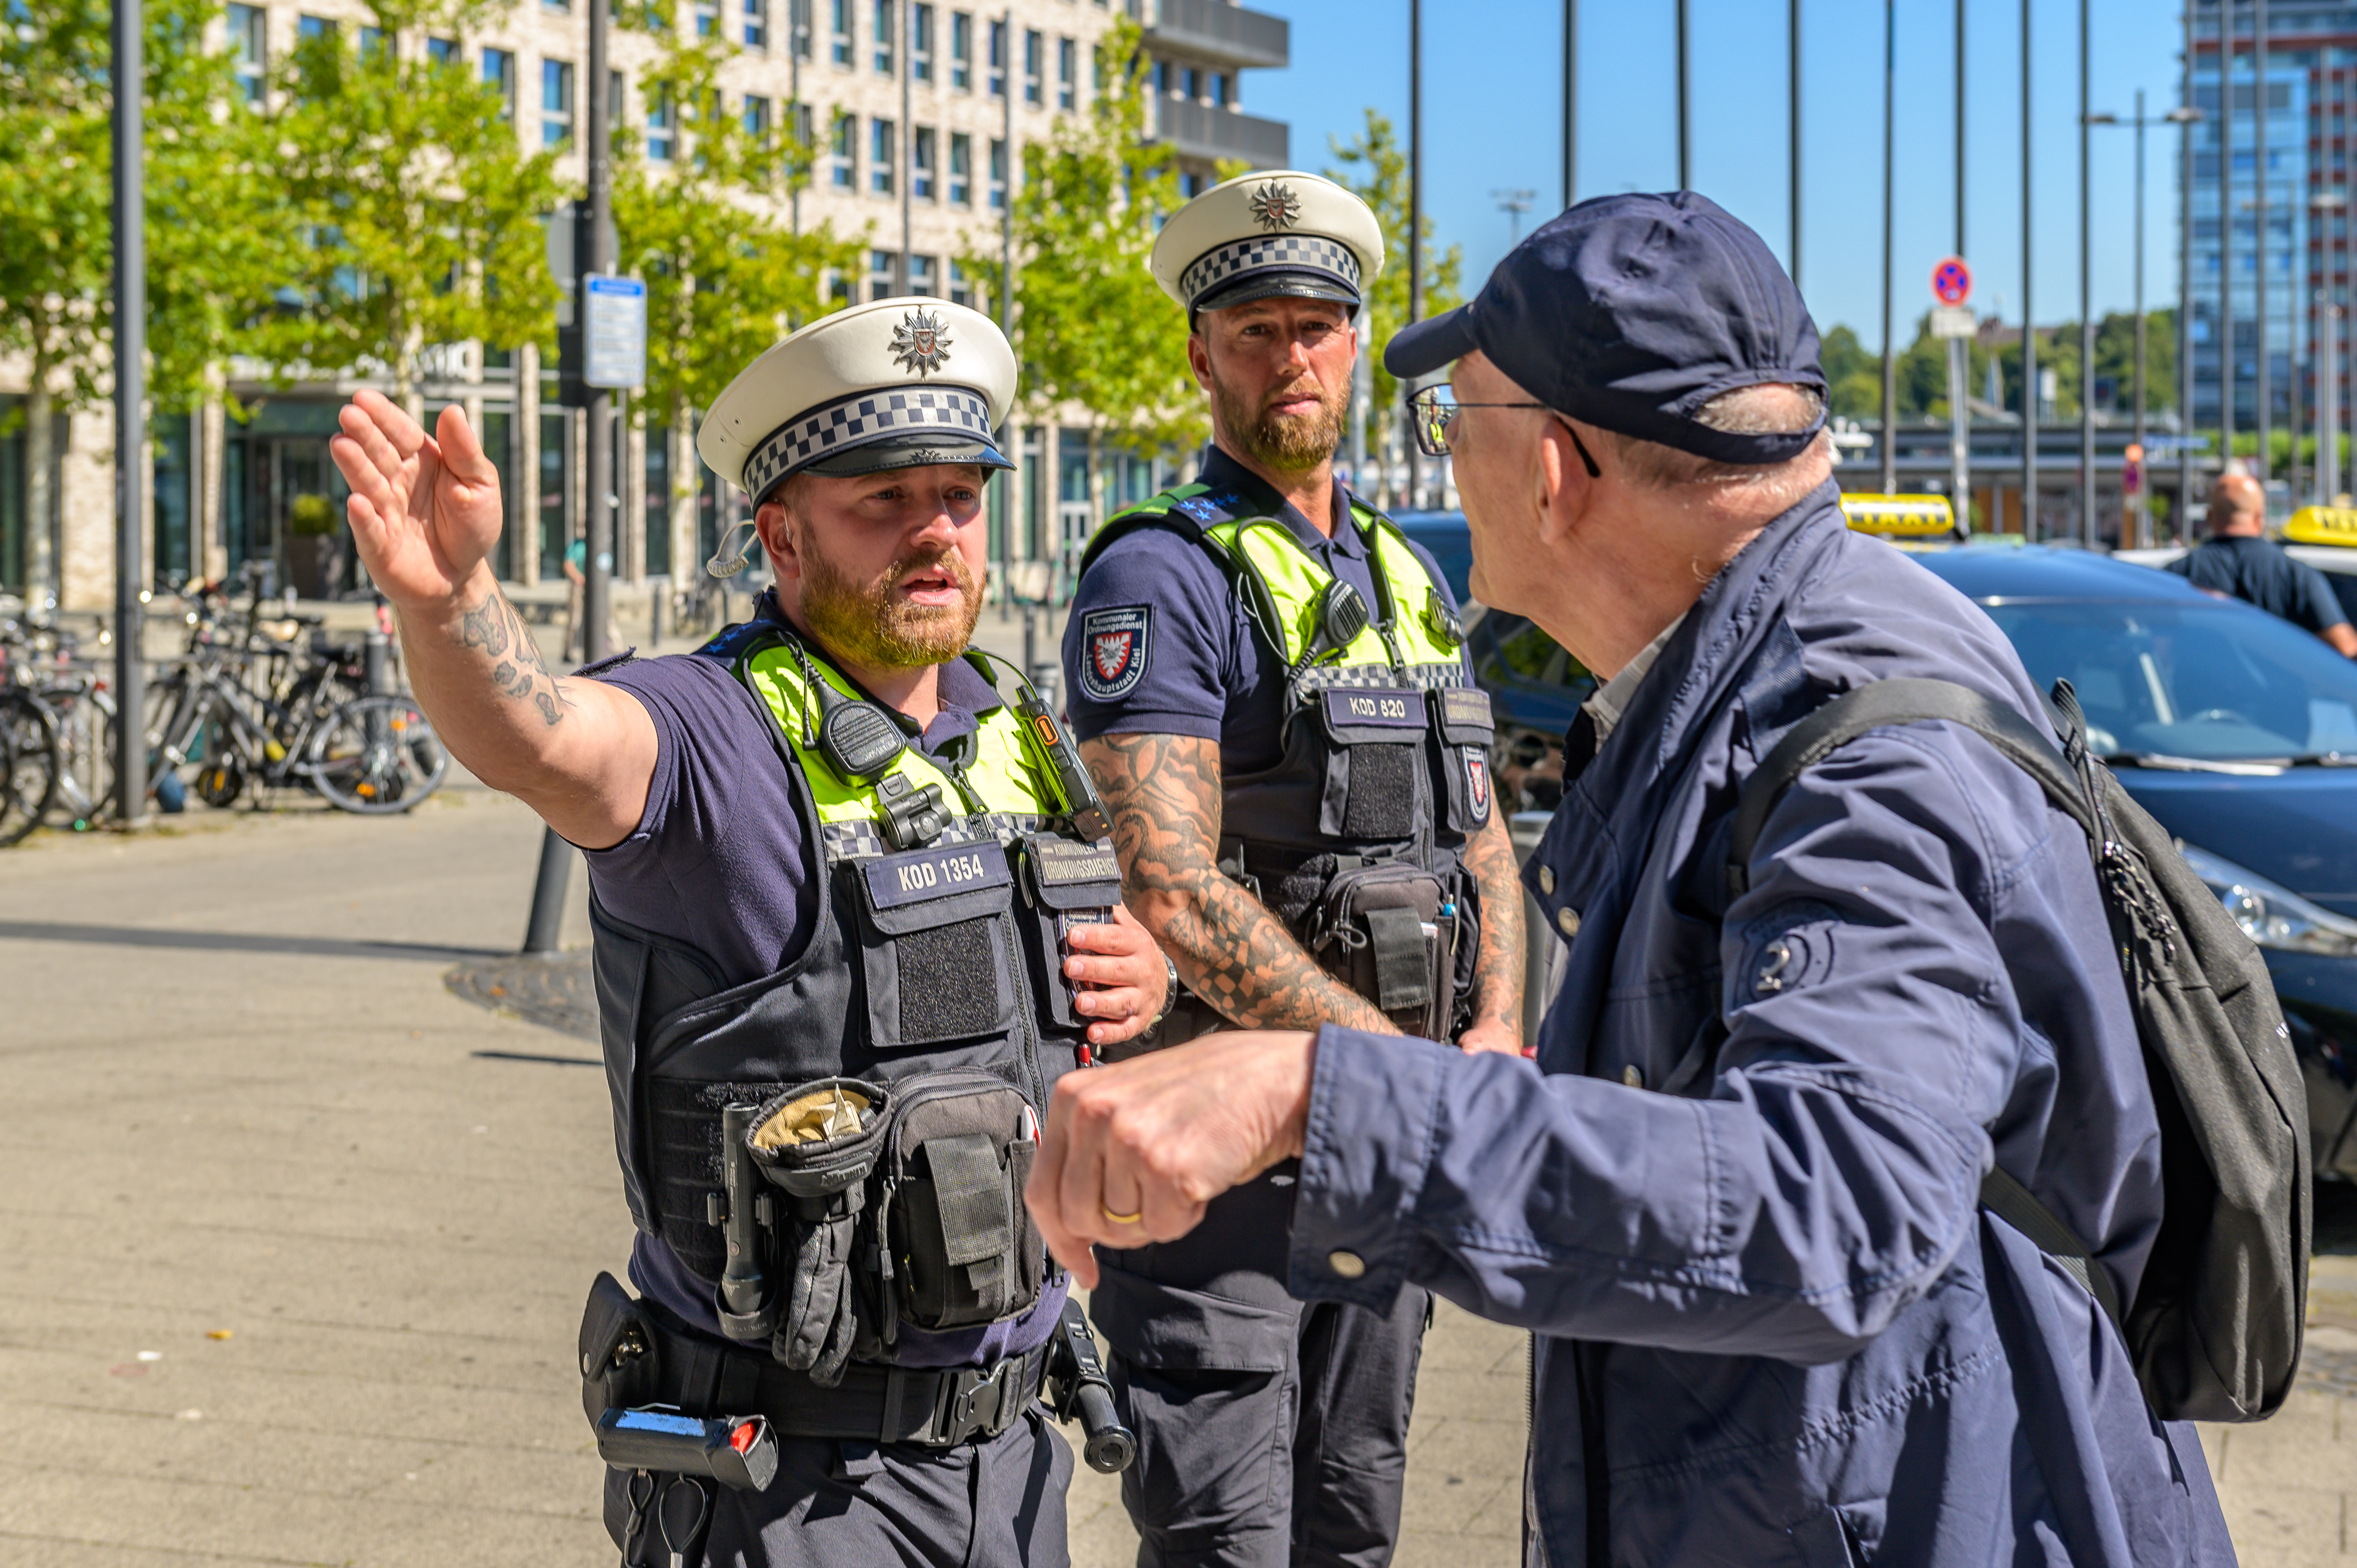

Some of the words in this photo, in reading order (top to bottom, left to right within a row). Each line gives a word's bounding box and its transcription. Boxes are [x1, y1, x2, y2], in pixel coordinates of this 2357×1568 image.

[1088, 621, 1143, 634] Ordnungsdienst
[1093, 613, 1137, 625] Kommunaler
[1086, 654, 1136, 694] Landeshauptstadt
[1131, 648, 1141, 667] Kiel
[1349, 697, 1377, 716] KOD
[1381, 699, 1405, 719] 820
[898, 864, 937, 892] KOD
[940, 853, 984, 883] 1354
[1044, 857, 1118, 880] ORDNUNGSDIENST
